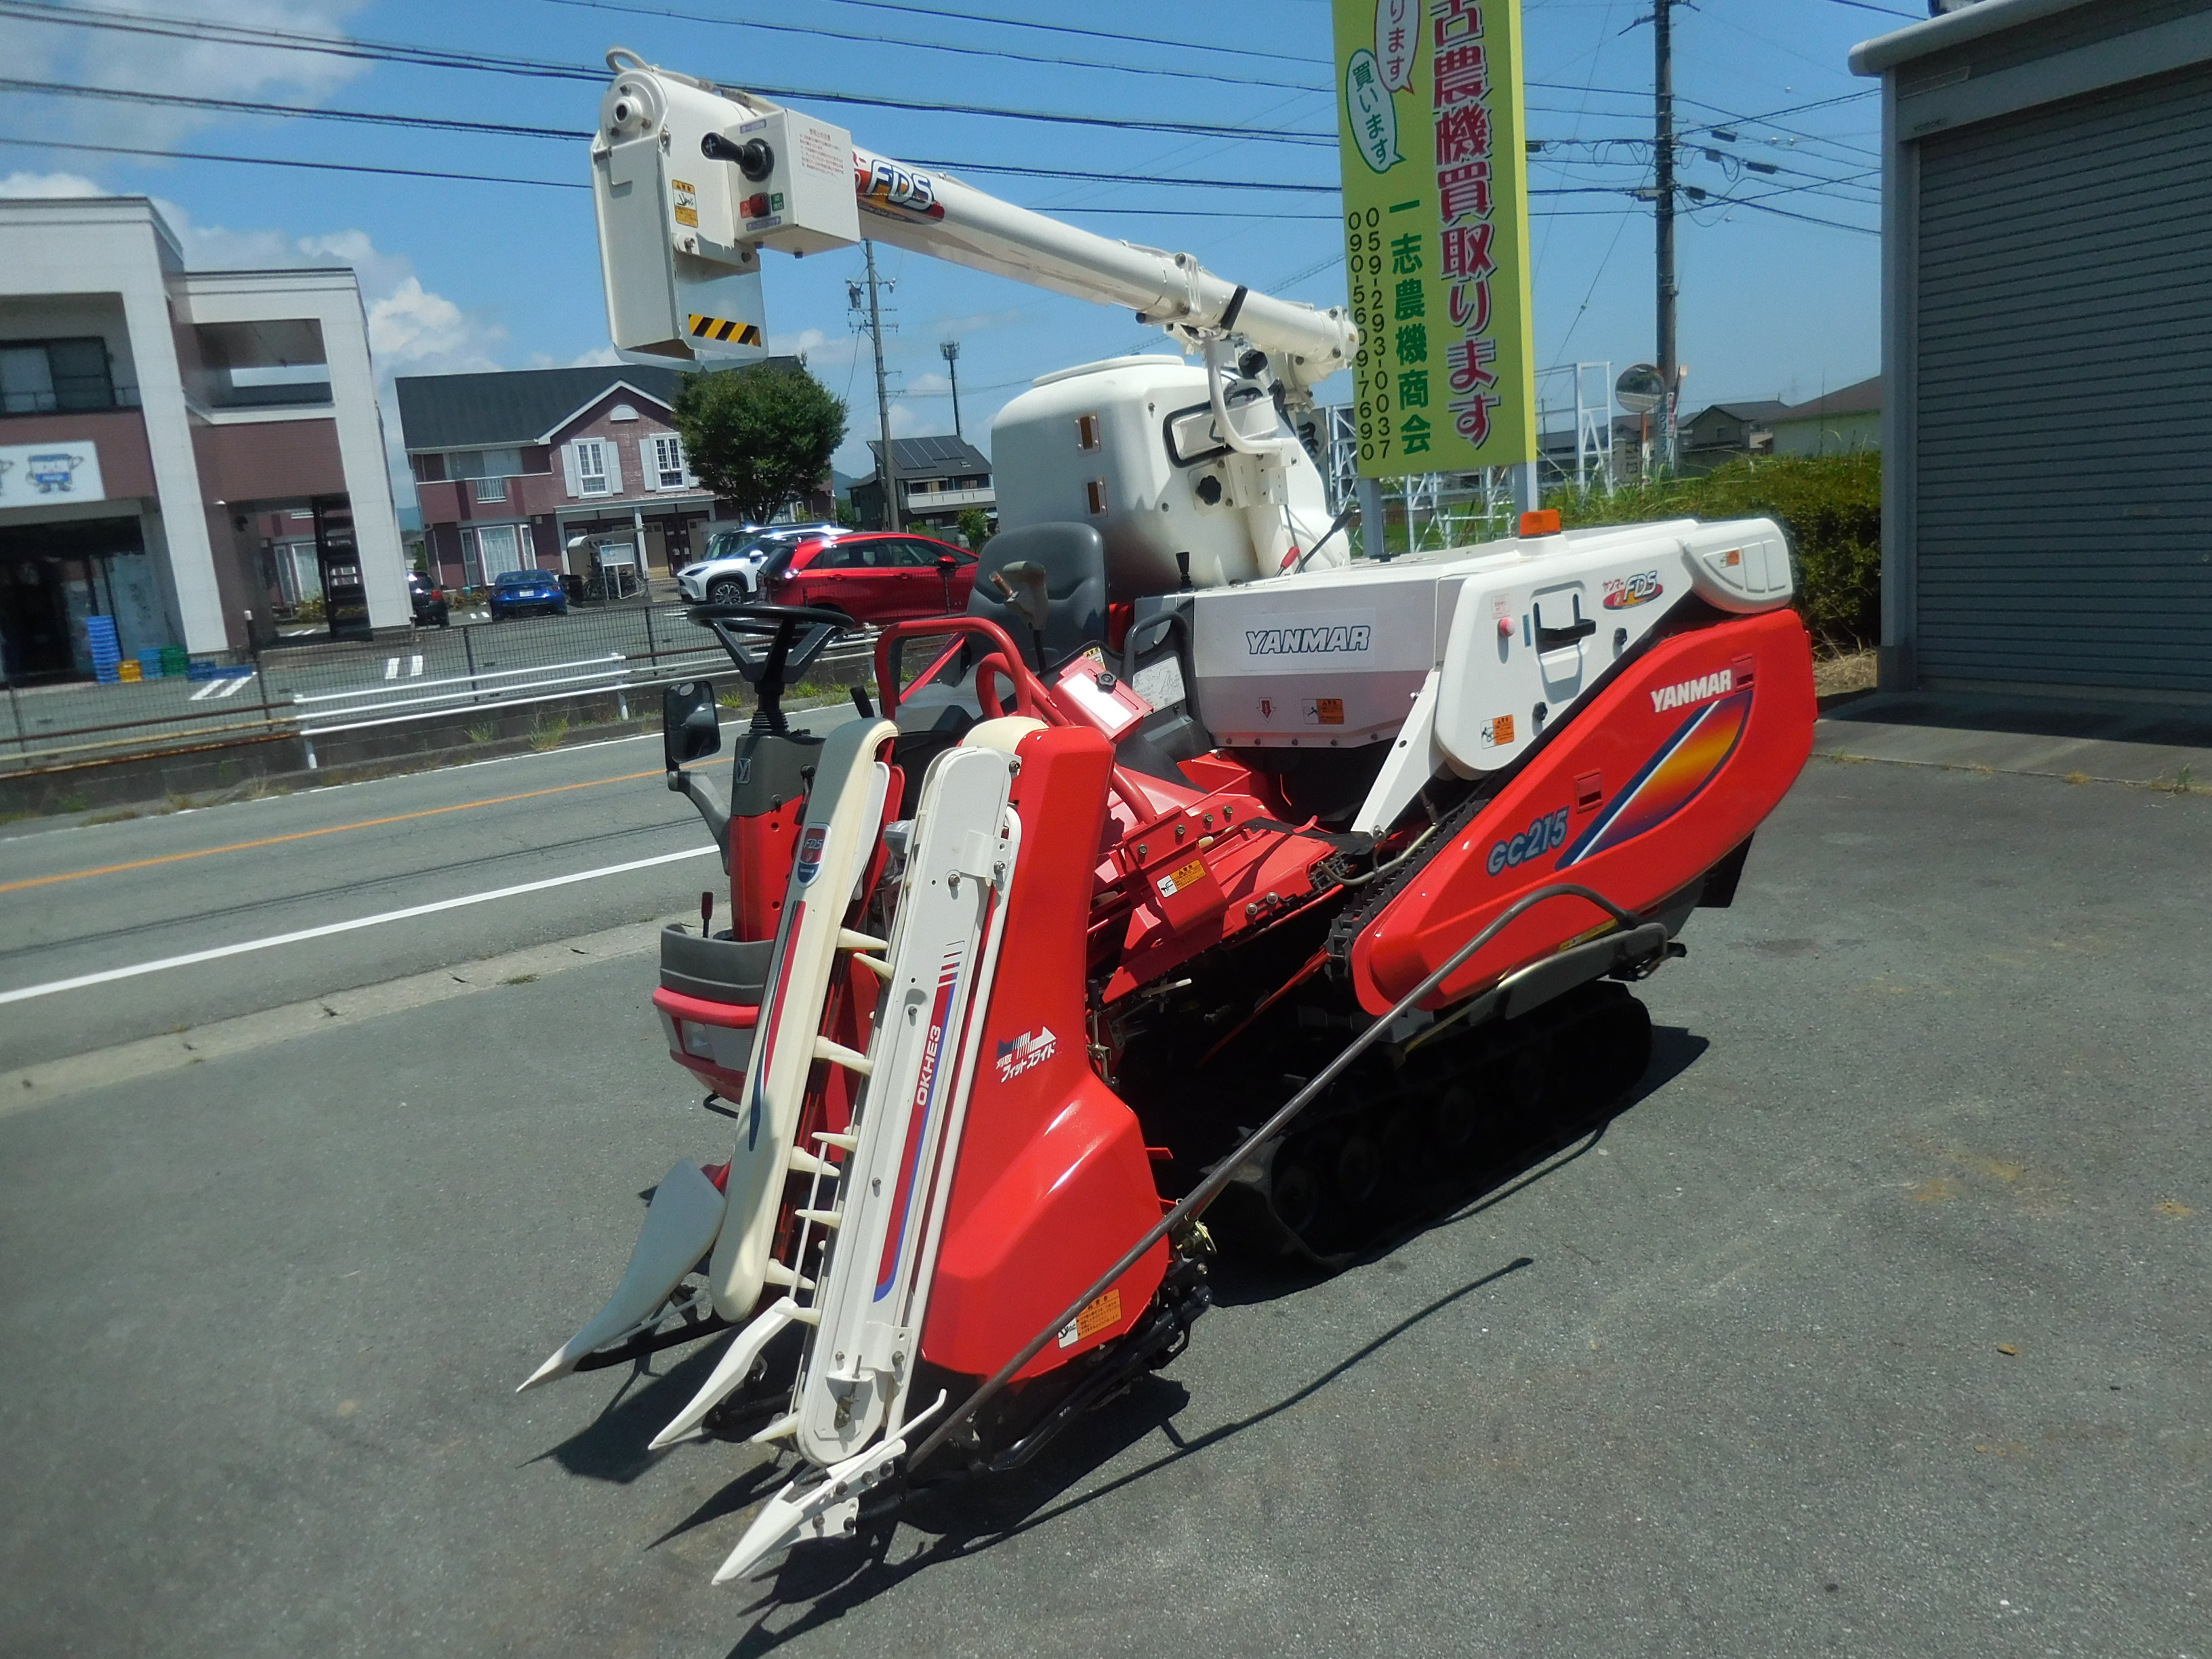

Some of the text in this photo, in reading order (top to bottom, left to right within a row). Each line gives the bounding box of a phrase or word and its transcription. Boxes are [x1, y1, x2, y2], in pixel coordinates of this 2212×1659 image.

[1353, 60, 1388, 165] 買います
[866, 159, 936, 211] FDS
[1348, 211, 1374, 461] 090-5609-7690
[1366, 207, 1391, 459] 059-293-0037
[1389, 199, 1432, 455] 一志農機商会
[1622, 570, 1658, 602] FDS
[1246, 625, 1371, 655] YANMAR
[1650, 668, 1732, 713] YANMAR
[803, 838, 824, 851] FDS
[1486, 804, 1570, 877] GC215
[916, 1025, 942, 1107] OKHE3
